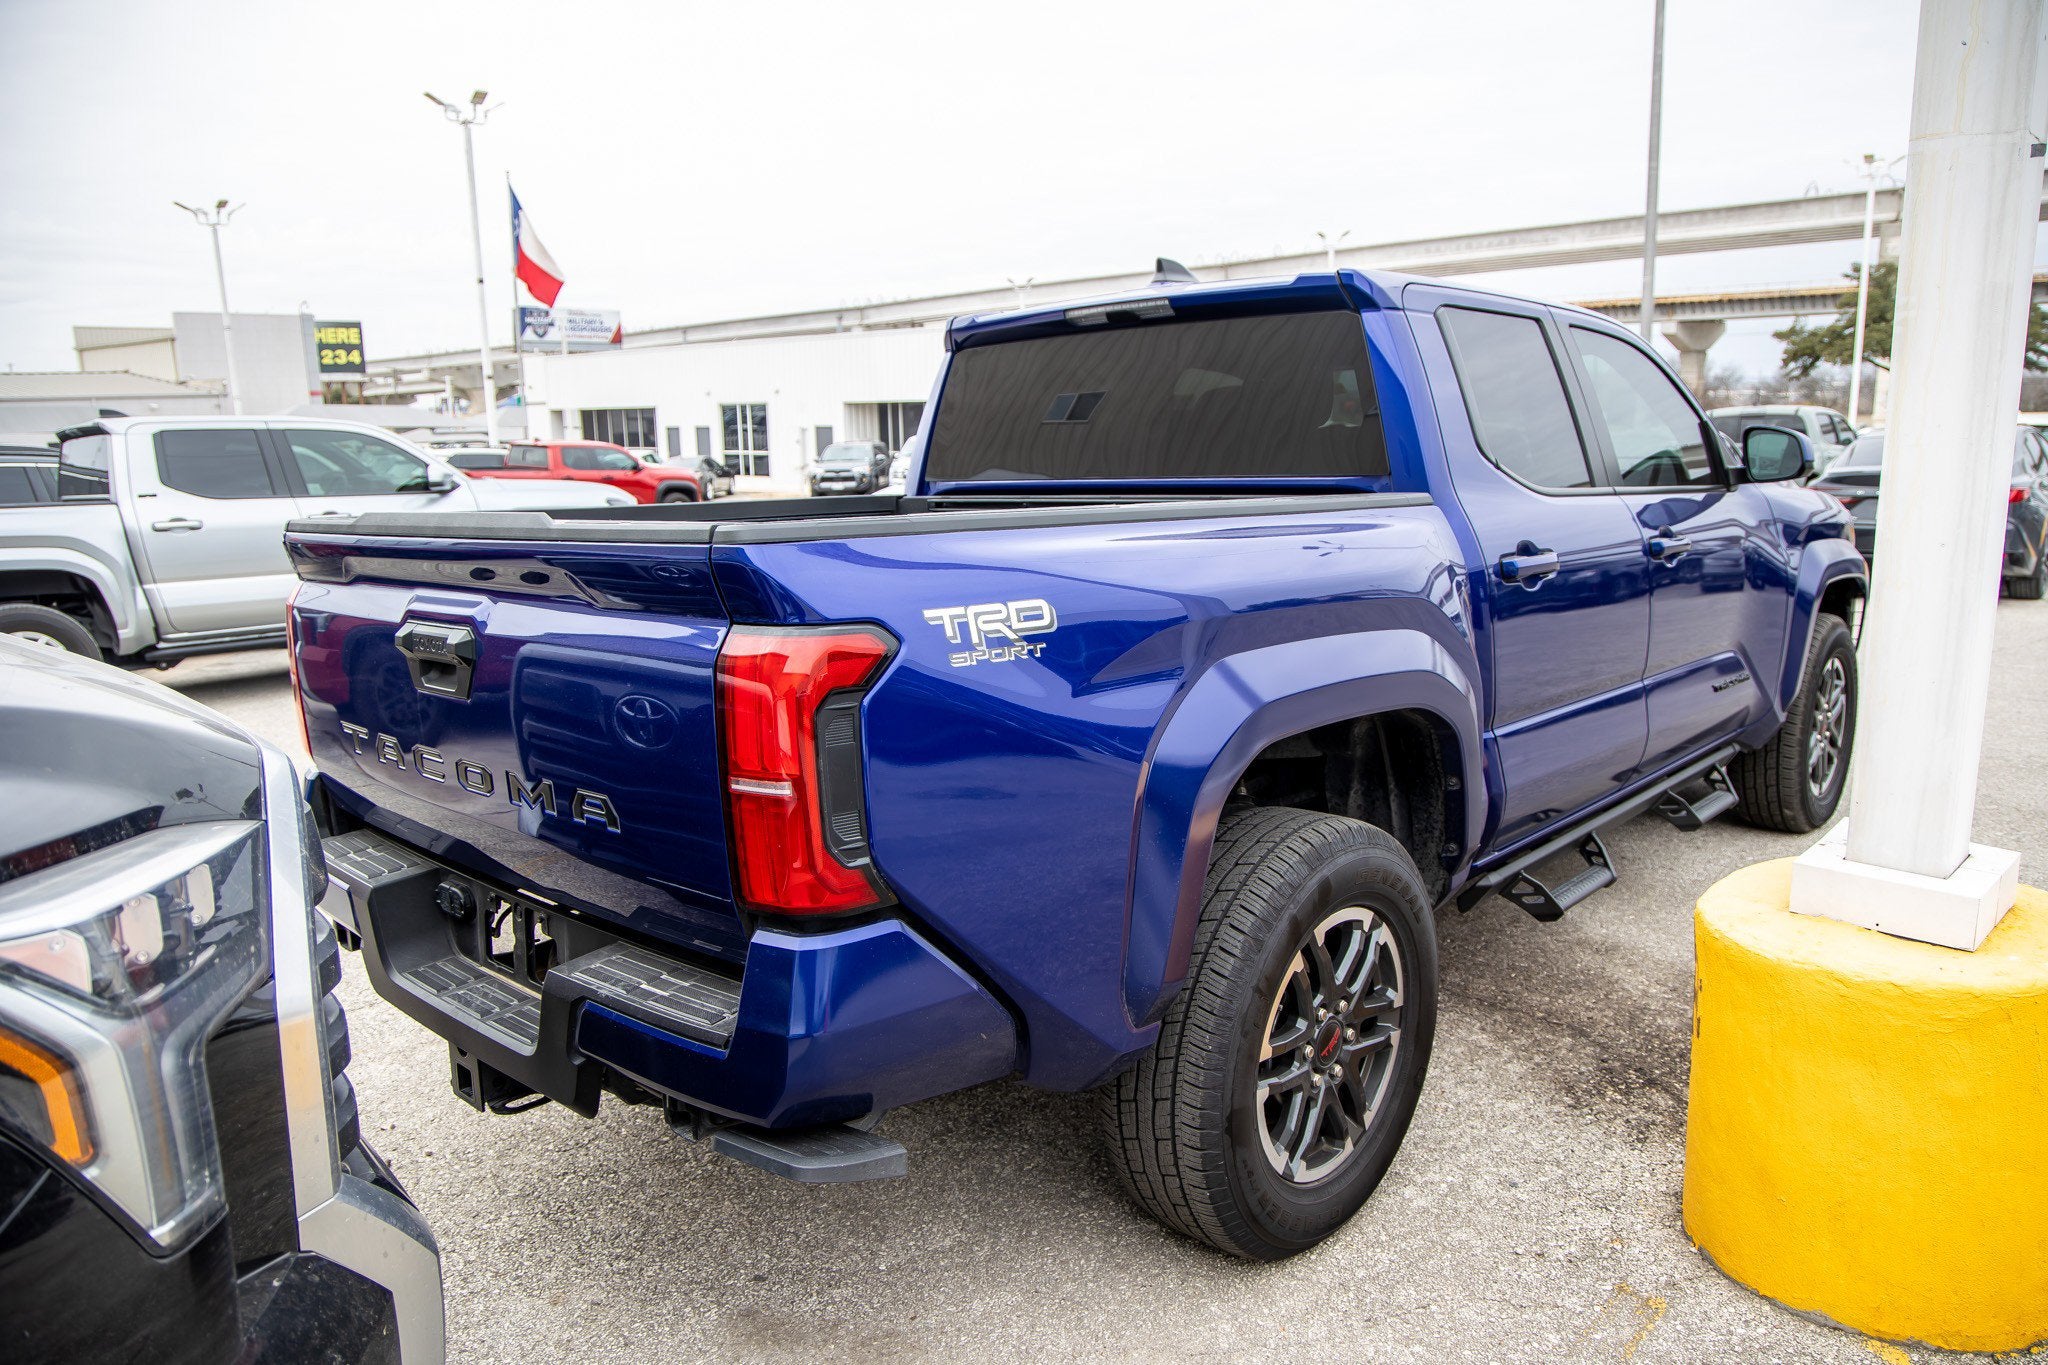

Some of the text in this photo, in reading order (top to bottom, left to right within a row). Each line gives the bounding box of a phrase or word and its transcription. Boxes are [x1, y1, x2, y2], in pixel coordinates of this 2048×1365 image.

[314, 327, 361, 345] HERE
[320, 349, 362, 365] 234
[922, 599, 1058, 650] TRD
[948, 642, 1047, 667] SPORT
[340, 720, 621, 834] TACOMA
